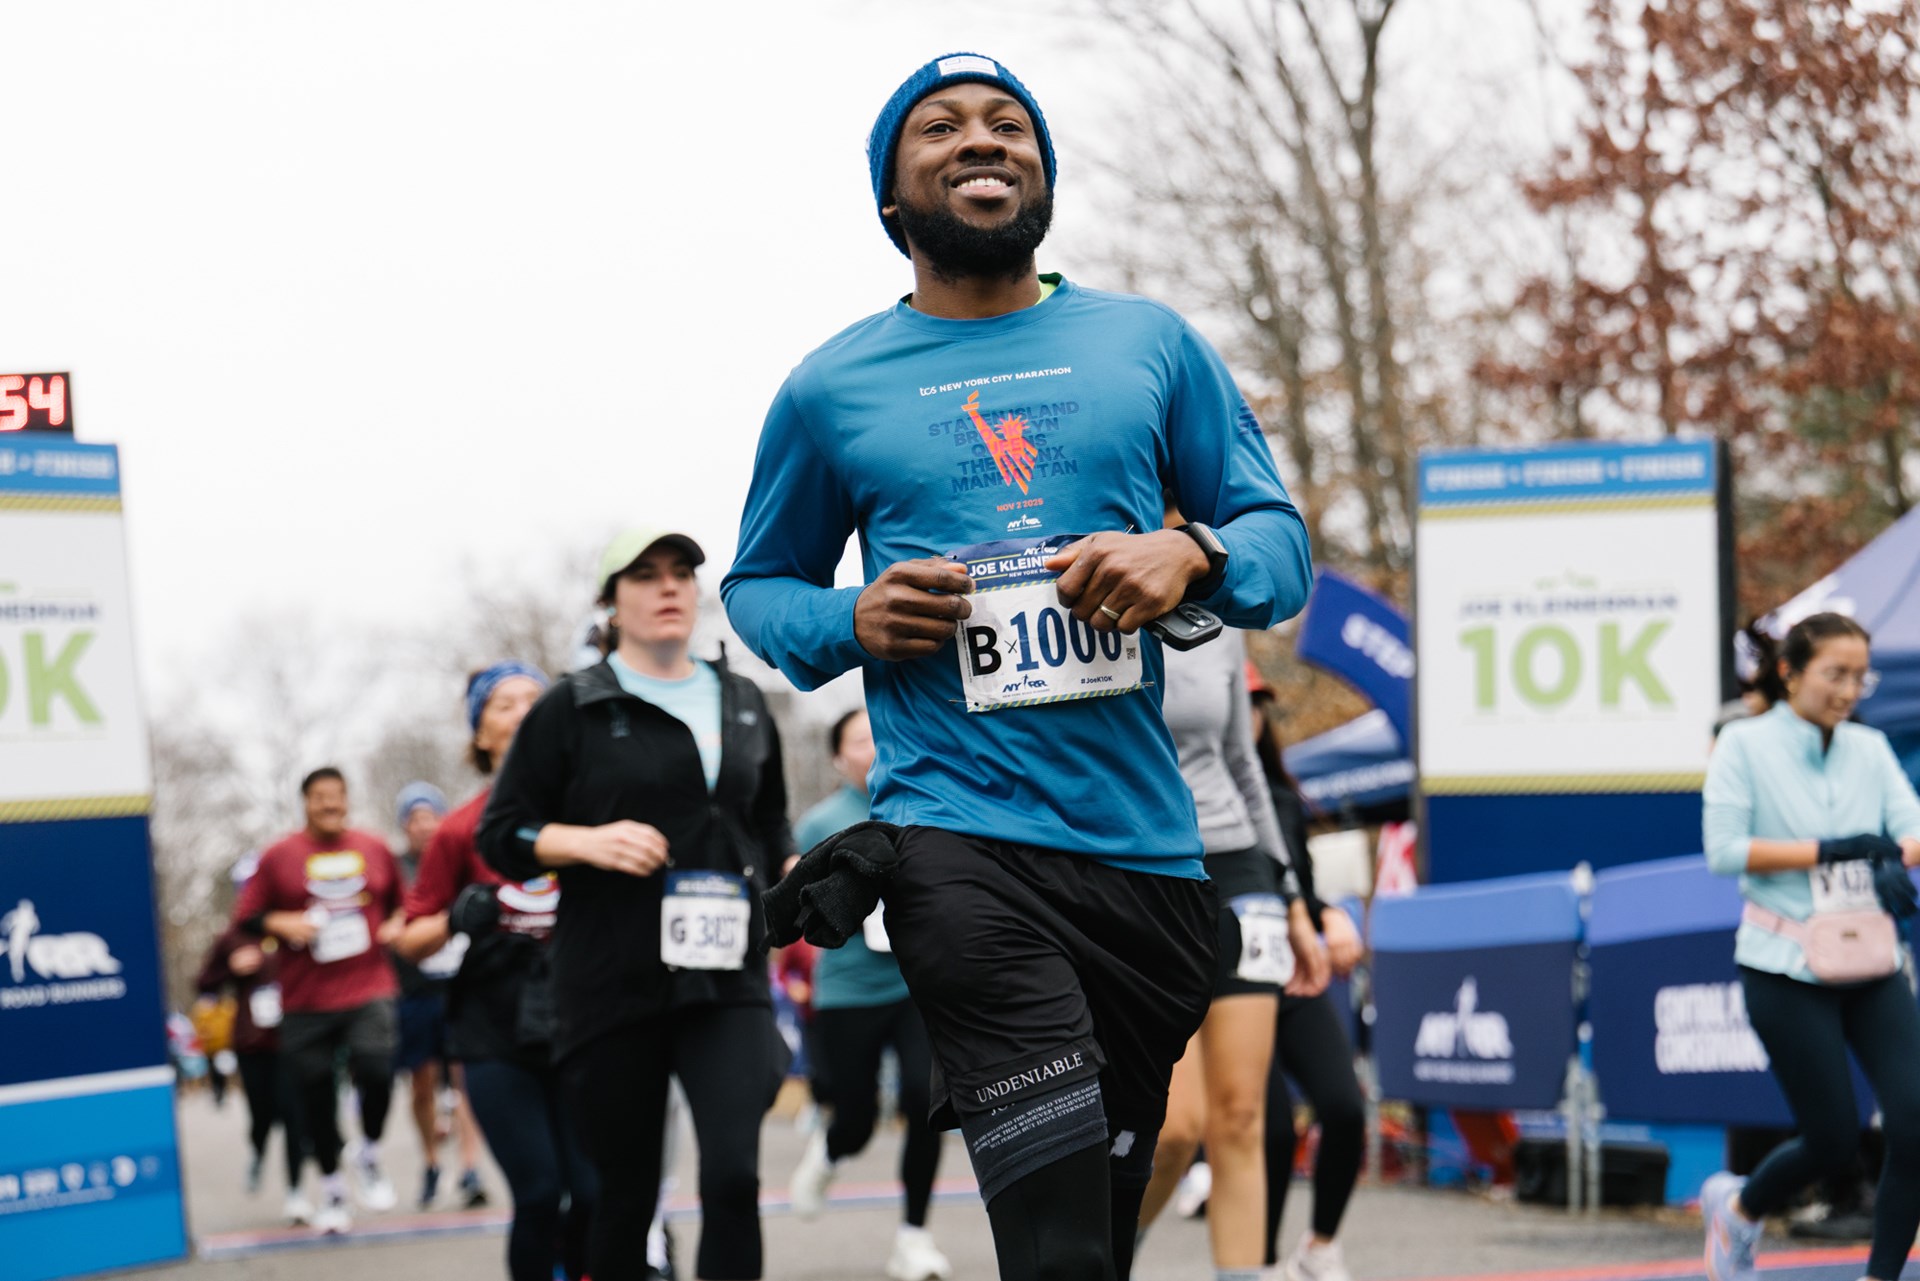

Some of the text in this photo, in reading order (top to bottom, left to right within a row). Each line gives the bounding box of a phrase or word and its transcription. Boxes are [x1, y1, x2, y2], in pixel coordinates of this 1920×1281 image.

[939, 382, 963, 393] NEW
[963, 377, 991, 388] YORK
[991, 374, 1013, 384] CITY
[1015, 367, 1071, 380] MARATHON
[1008, 401, 1080, 421] ISLAND
[952, 459, 1078, 493] MANHTAN
[957, 457, 996, 477] THE
[996, 503, 1015, 512] NOV
[1016, 501, 1022, 509] 2
[969, 555, 1055, 577] JOE KLEINE
[966, 626, 1001, 676] B
[1459, 620, 1677, 711] 10K
[976, 1052, 1083, 1103] UNDENIABLE
[1003, 1124, 1018, 1136] THAT
[1018, 1107, 1053, 1126] WHOEVER
[1054, 1094, 1086, 1111] BELIEVES
[1013, 1113, 1026, 1123] THE
[1026, 1100, 1053, 1116] WORLD
[1054, 1093, 1071, 1105] THAT
[1022, 1121, 1036, 1132] BUT
[1036, 1113, 1057, 1126] HAVE
[1057, 1101, 1086, 1117] ETERNAL
